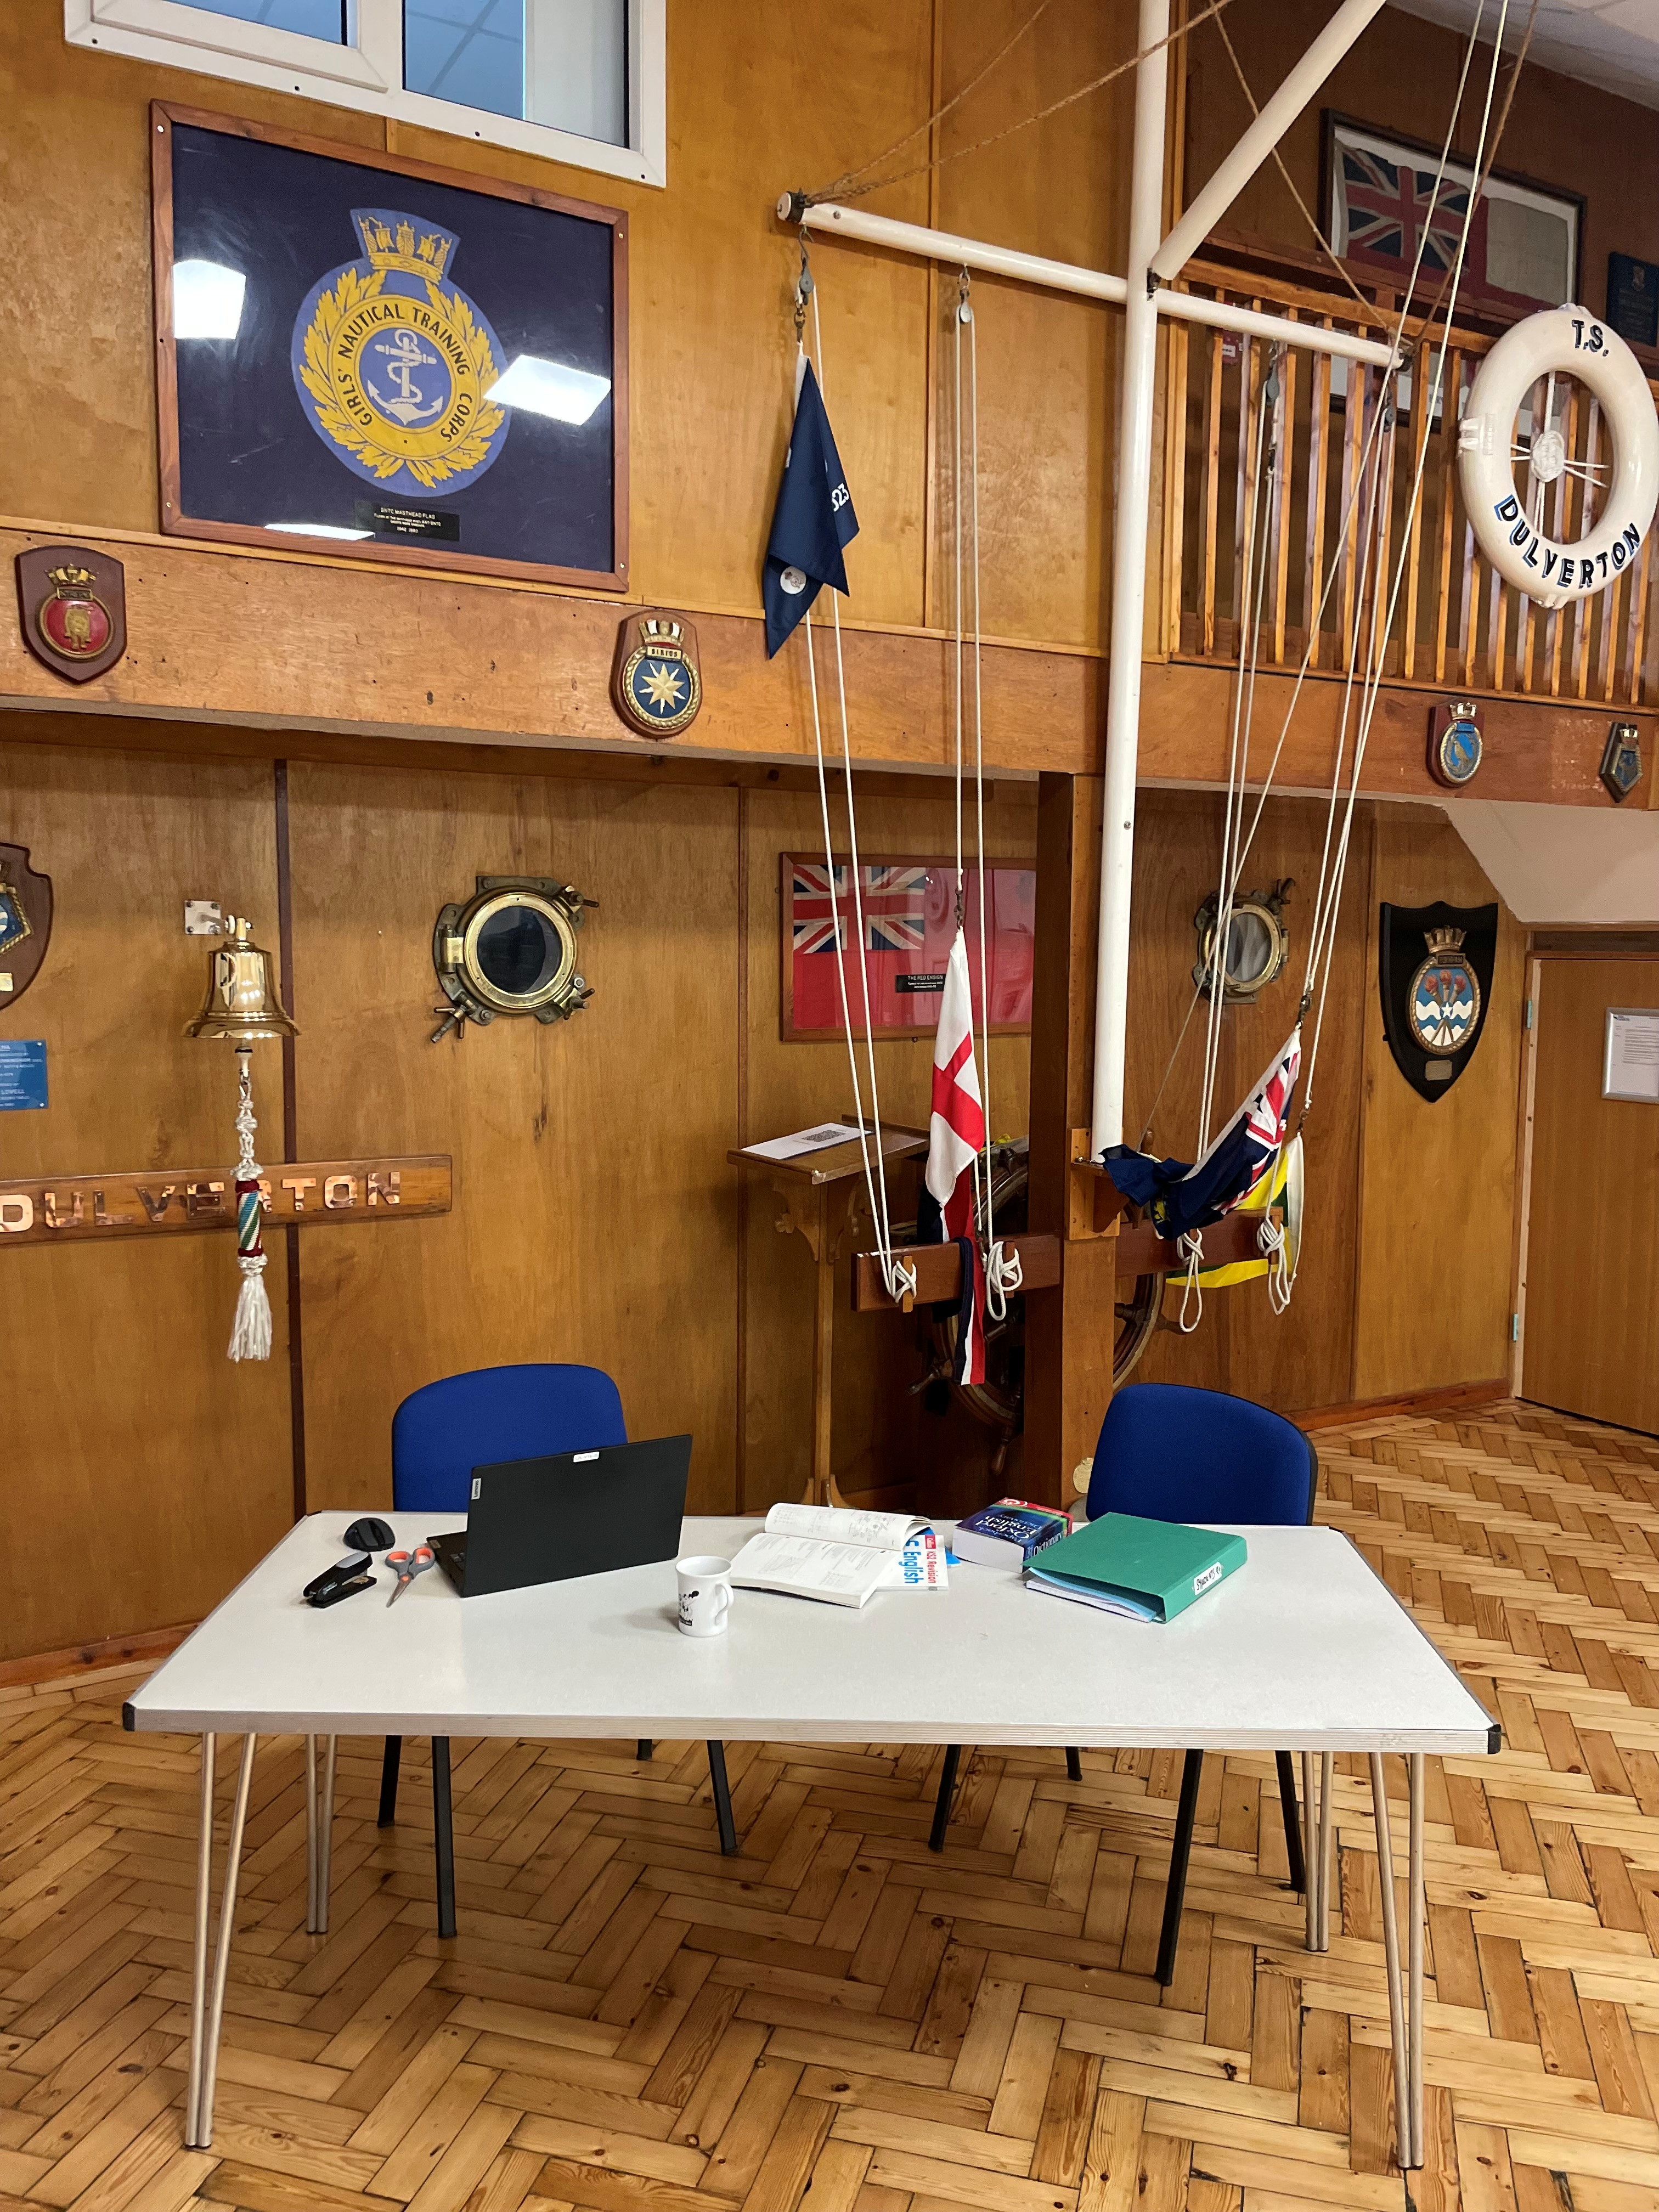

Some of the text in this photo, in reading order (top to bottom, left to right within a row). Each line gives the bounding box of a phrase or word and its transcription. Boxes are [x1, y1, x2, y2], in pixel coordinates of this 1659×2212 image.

[337, 303, 405, 359] NAUTICAL
[412, 307, 471, 375] TRAINING
[1571, 319, 1610, 357] T.S.
[440, 393, 473, 443] CORPS
[394, 510, 422, 518] MASTHEAD
[1493, 494, 1641, 589] DULVERTON
[651, 648, 678, 657] SIRIUS
[975, 1520, 1030, 1539] Oxford
[985, 1515, 1037, 1535] English
[898, 1551, 924, 1584] English
[926, 1551, 939, 1584] KS2 Revision
